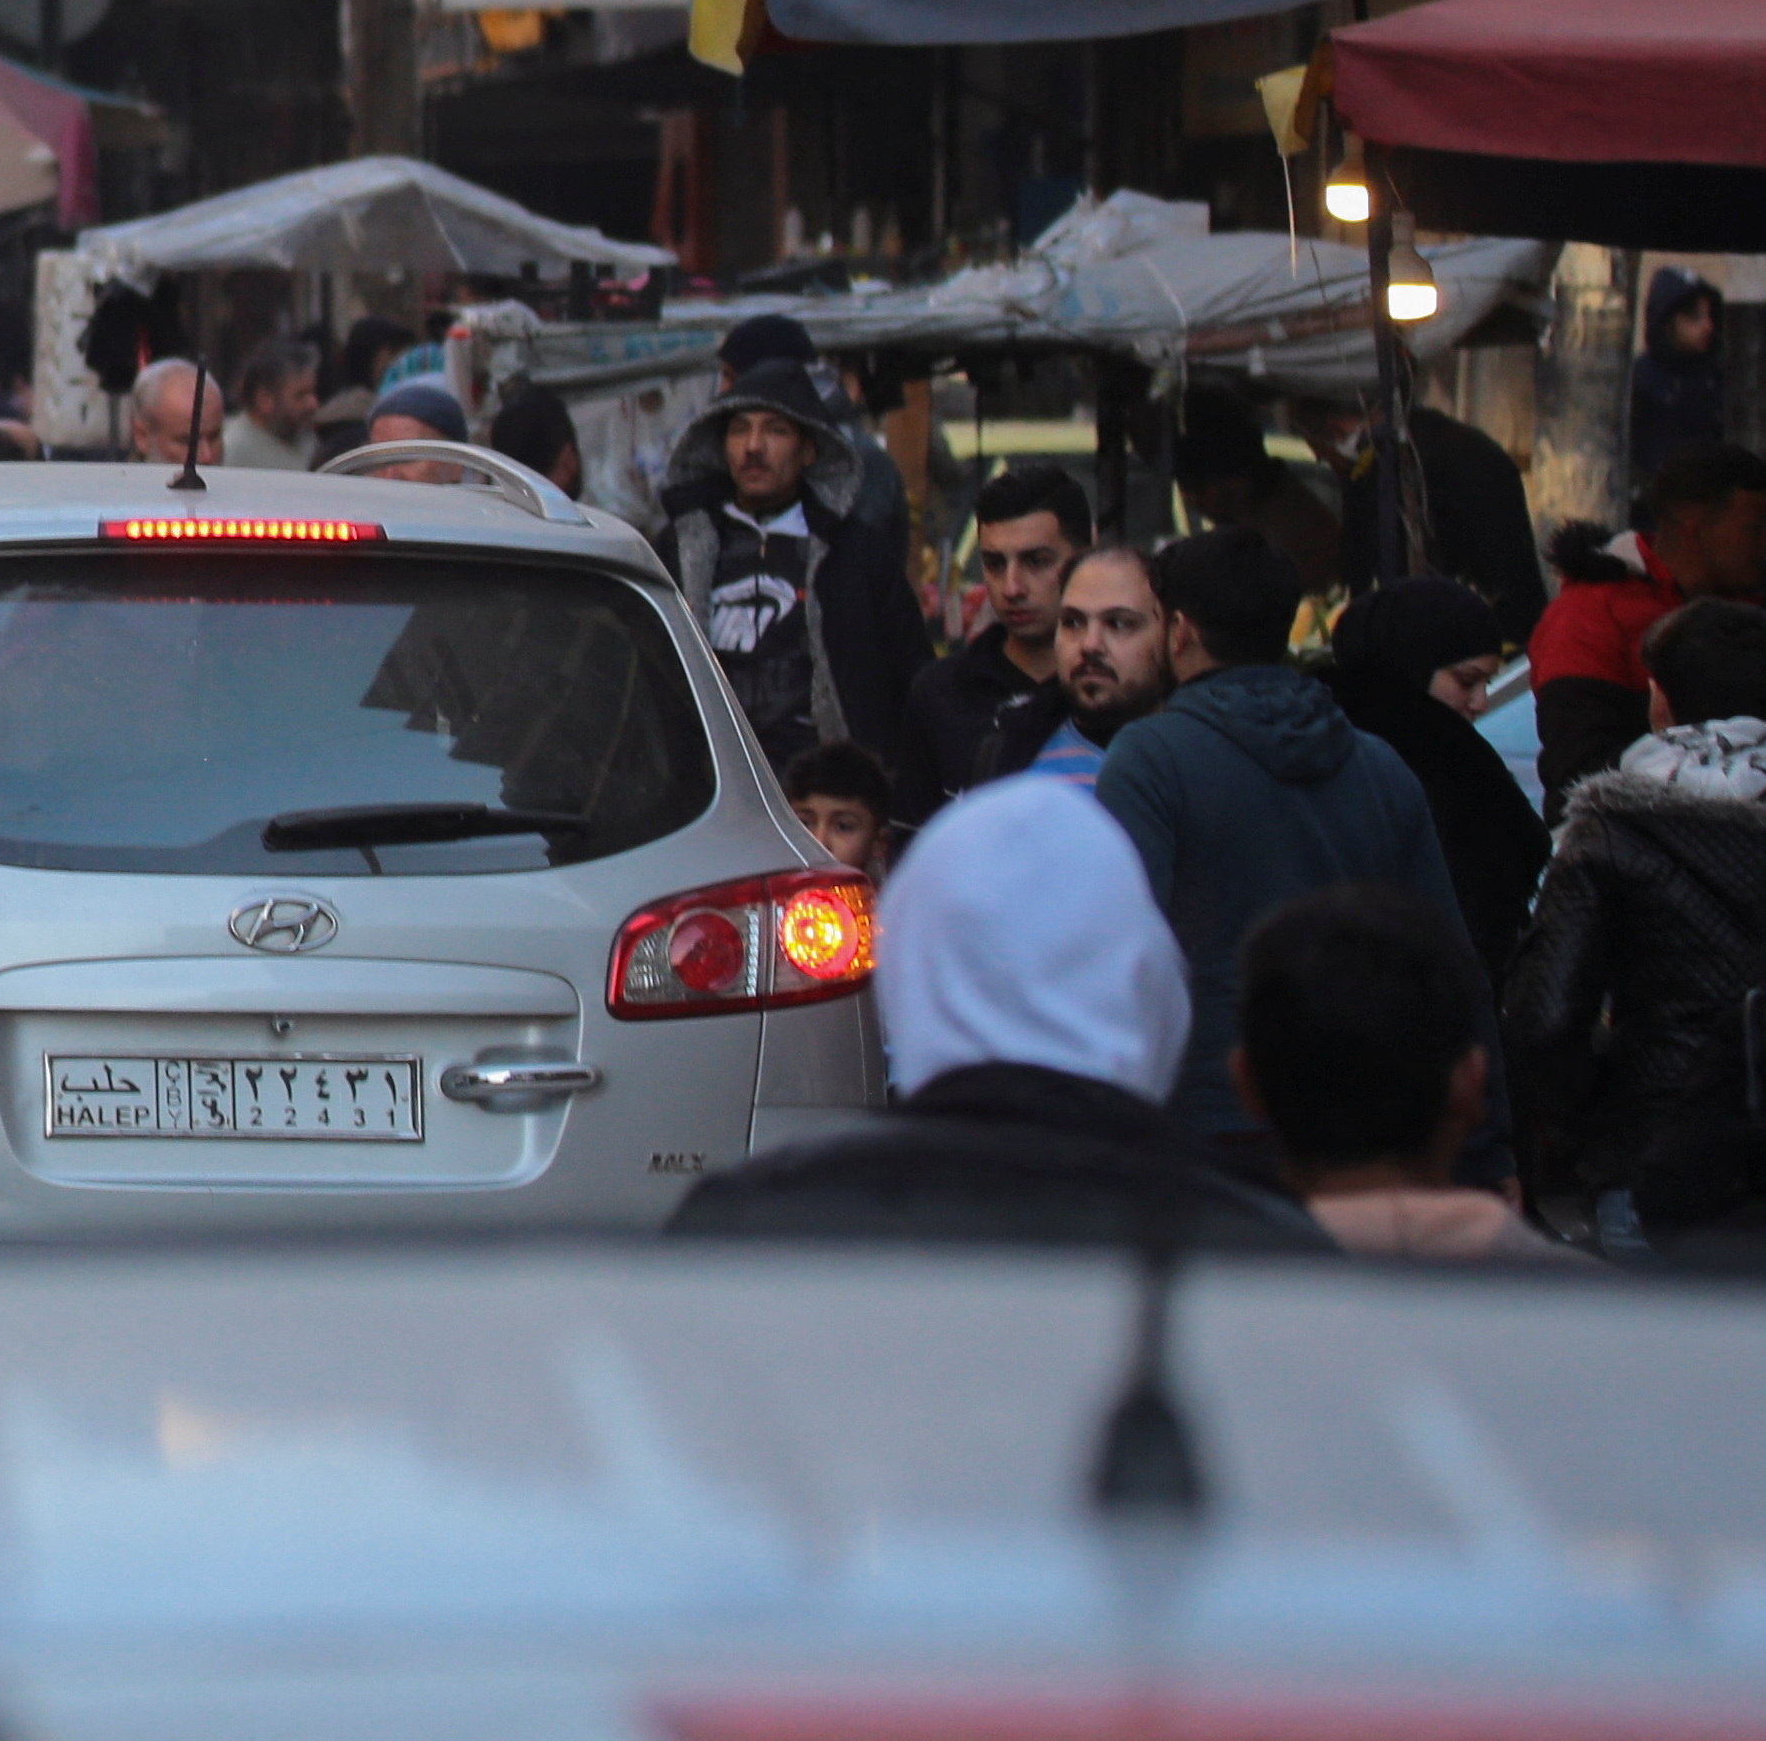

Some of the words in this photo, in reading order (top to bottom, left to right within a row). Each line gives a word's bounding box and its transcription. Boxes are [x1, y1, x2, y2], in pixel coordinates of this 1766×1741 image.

[57, 1063, 141, 1103] حلب
[244, 1064, 400, 1106] ٢٢٤٣١
[56, 1105, 152, 1127] HALEP
[249, 1106, 397, 1128] 22431
